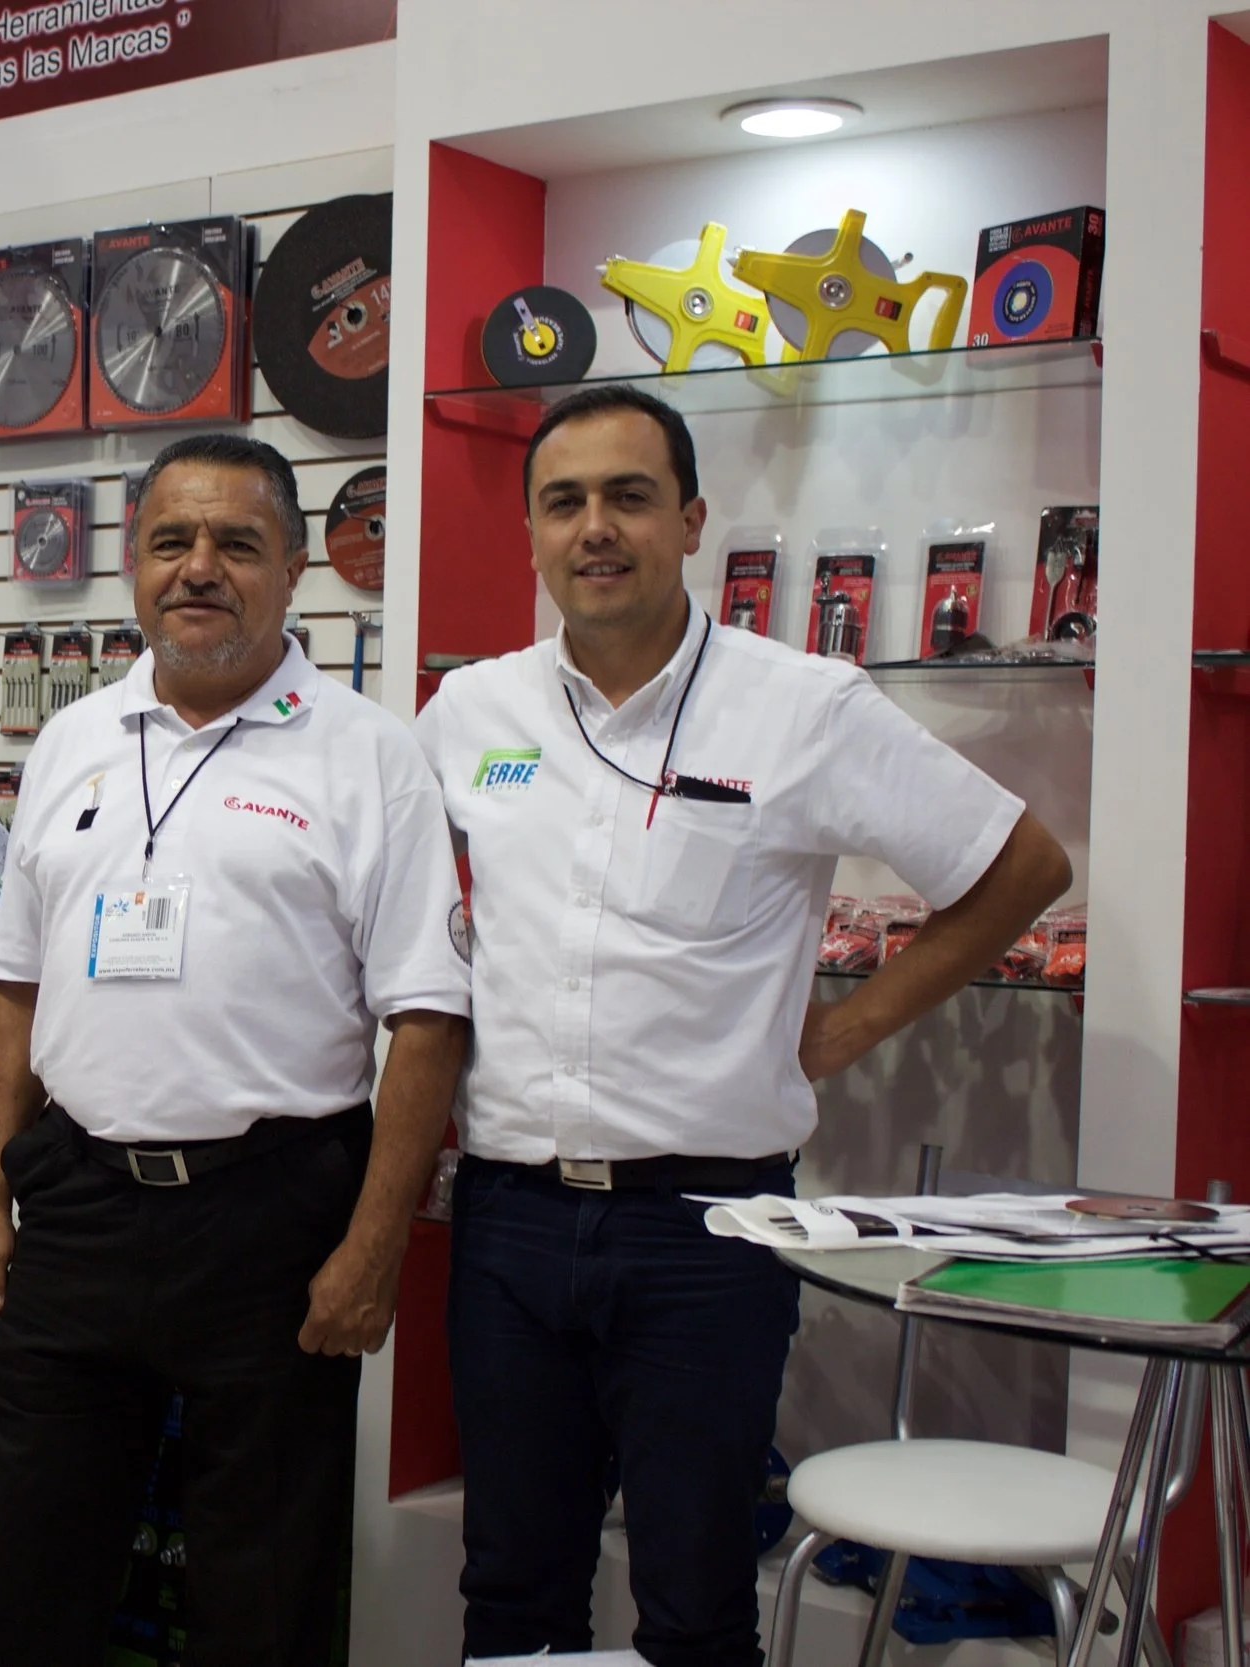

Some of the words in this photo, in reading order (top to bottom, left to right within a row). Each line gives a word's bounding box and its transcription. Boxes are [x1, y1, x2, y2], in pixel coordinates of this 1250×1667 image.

[24, 49, 61, 80] las
[69, 24, 170, 70] Marcas
[1023, 215, 1074, 237] AVANTE
[109, 234, 150, 249] AVANTE
[972, 332, 990, 347] 30
[241, 801, 311, 832] AVANTE
